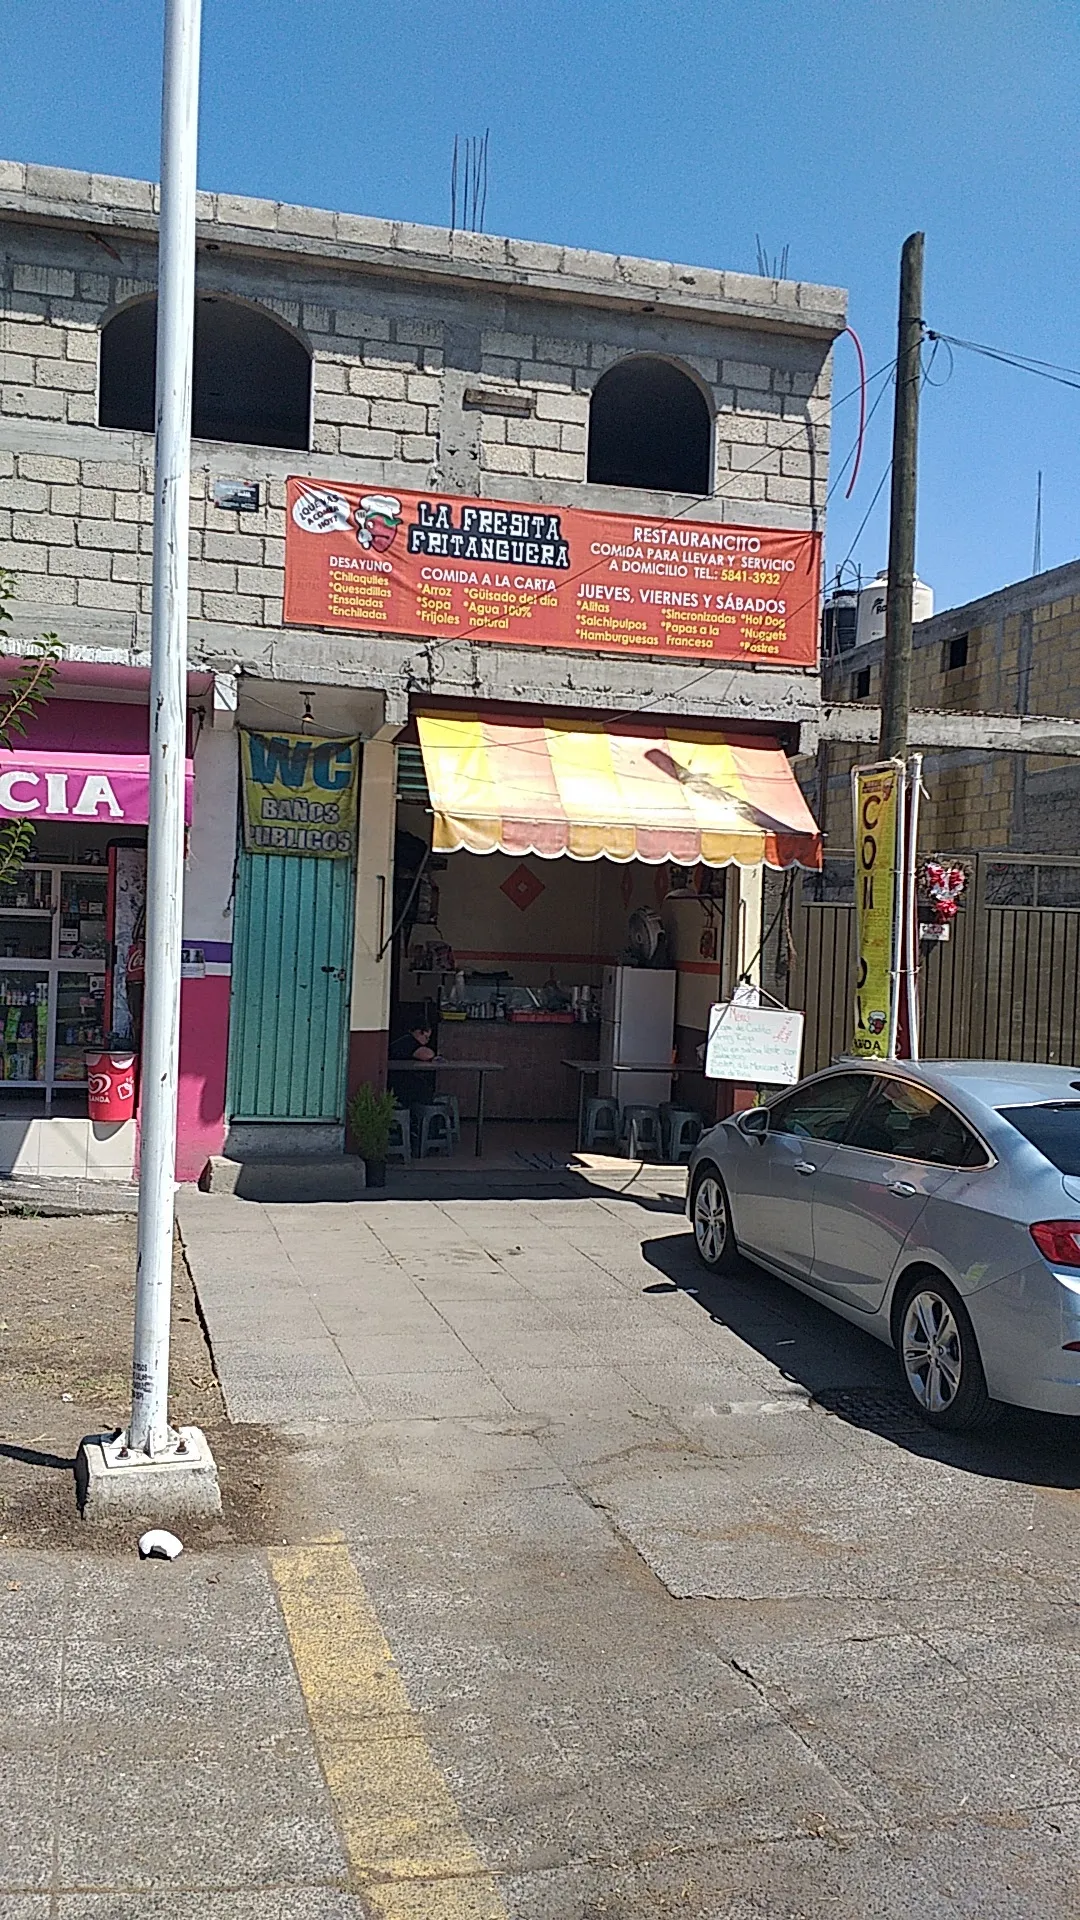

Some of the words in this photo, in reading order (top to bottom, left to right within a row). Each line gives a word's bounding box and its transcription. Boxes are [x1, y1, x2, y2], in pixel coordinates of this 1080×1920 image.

[420, 503, 449, 529] LA
[463, 508, 560, 541] FRESITA
[633, 526, 761, 553] RESTAURANCITO
[411, 530, 569, 567] FRITANGUERA
[329, 556, 393, 573] DESAYUNO
[590, 542, 644, 559] COMIDA
[647, 547, 679, 562] PARA
[682, 551, 724, 566] LLEVAR
[727, 555, 736, 567] Y
[741, 556, 796, 572] SERVICIO
[333, 570, 389, 586] Chilaquiles
[420, 567, 478, 585] COMIDA
[481, 574, 492, 586] A
[495, 574, 511, 587] LA
[514, 577, 557, 592] CARTA
[609, 559, 619, 571] A
[622, 560, 688, 577] DOMICILIO
[694, 567, 718, 580] TEL.:
[720, 569, 780, 585] 5841-3932
[333, 582, 392, 597] Quesadillas
[421, 584, 452, 597] Arroz
[333, 594, 384, 609] Ensaladas
[421, 598, 451, 612] Sopa
[519, 594, 537, 605] del
[577, 583, 635, 604] JUEVES,
[639, 588, 699, 608] VIERNES
[703, 594, 713, 609] Y
[716, 592, 786, 614] SÁBADOS
[581, 600, 610, 613] Alitas
[332, 605, 387, 620] Enchiladas
[421, 610, 460, 625] Frijoles
[468, 602, 500, 616] Agua
[503, 604, 532, 618] 100%
[665, 608, 736, 624] Sincronizadas
[469, 617, 509, 629] natural
[580, 614, 647, 631] Salchipulpos
[665, 621, 697, 635] Papas
[699, 626, 707, 635] a
[709, 624, 720, 636] la
[745, 613, 762, 625] Hot
[765, 615, 786, 629] Dog
[580, 629, 659, 645] Hamburguesas
[666, 634, 713, 648] Francesa
[744, 627, 787, 642] Nuggets
[744, 641, 780, 654] Postres
[249, 734, 352, 790] WC
[0, 771, 124, 817] CIA
[262, 797, 340, 824] BAÑOS
